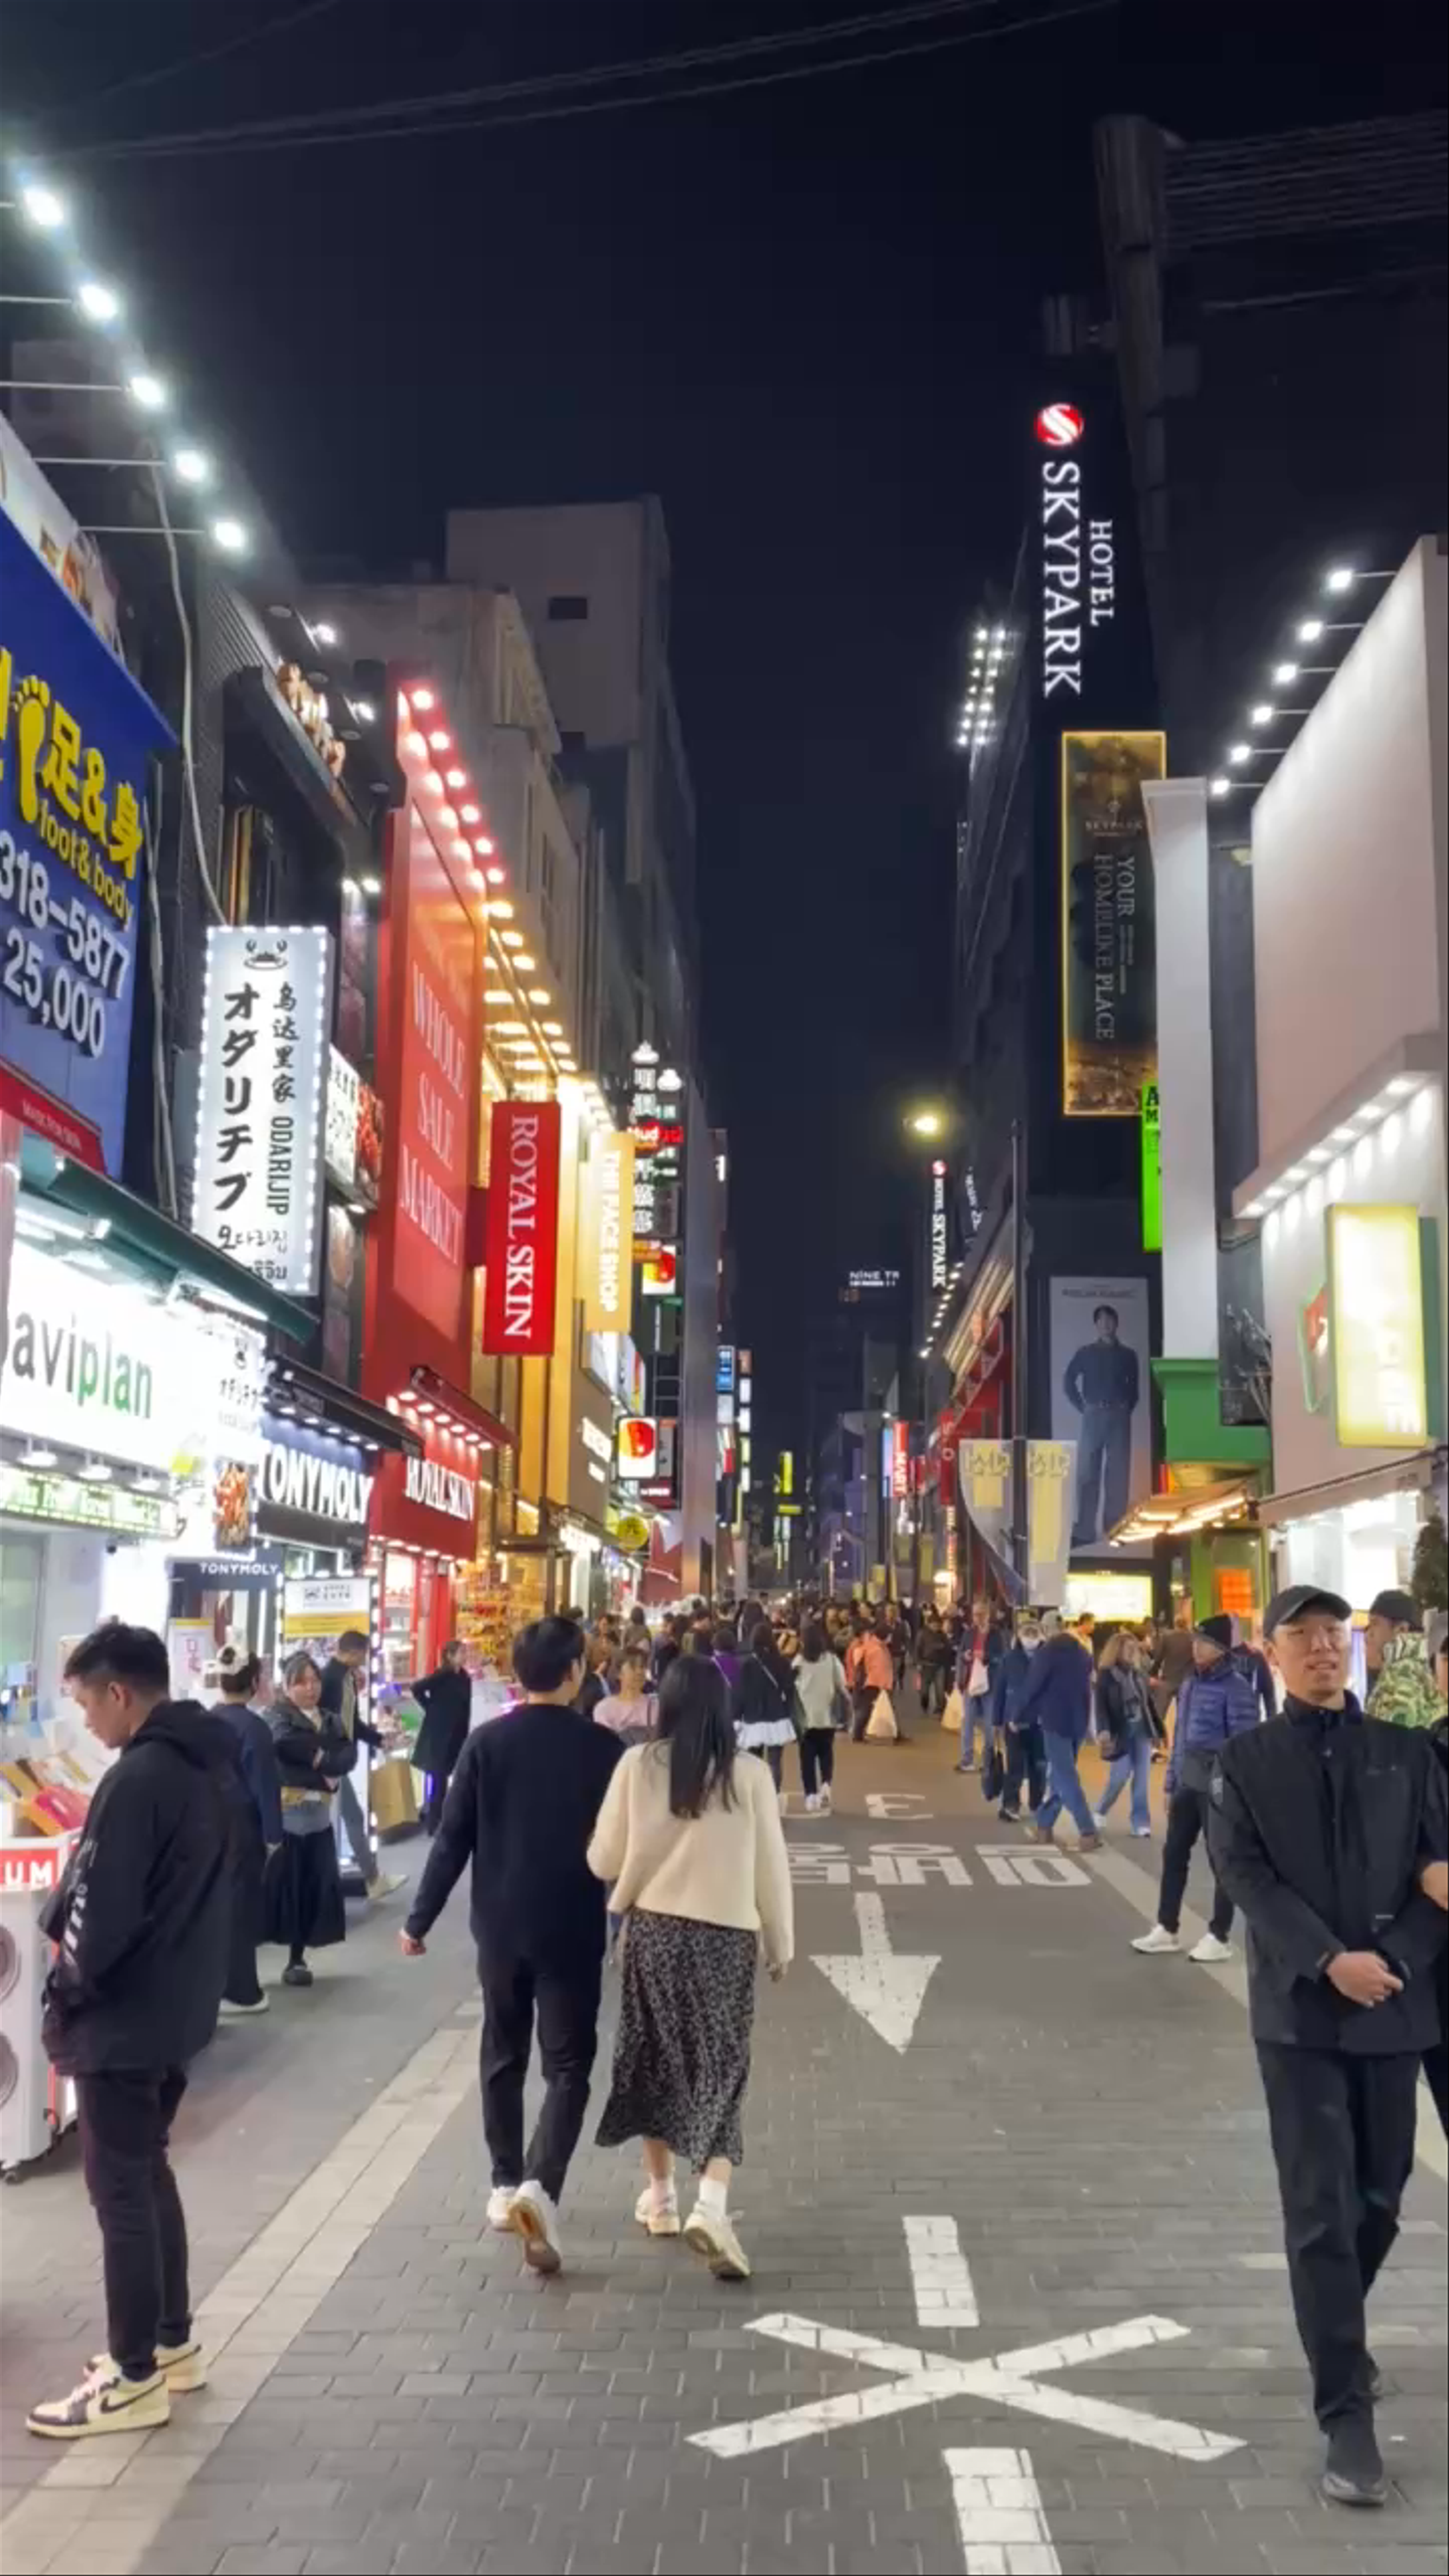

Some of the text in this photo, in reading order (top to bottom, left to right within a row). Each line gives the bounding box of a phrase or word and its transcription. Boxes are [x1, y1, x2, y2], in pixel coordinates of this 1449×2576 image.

[1043, 461, 1081, 698] SKYPARK
[1089, 520, 1114, 626] HOTEL
[0, 833, 130, 998] 318-5877
[1118, 856, 1134, 916] YOUR
[5, 926, 107, 1058] 25,000
[413, 961, 465, 1099] WHOLE
[1095, 973, 1114, 1040] PLACE
[266, 1117, 293, 1215] ODARIJIP
[417, 1072, 453, 1170] SALE
[400, 1144, 463, 1265] MARKET
[503, 1115, 538, 1338] ROYAL SKIN
[932, 1214, 946, 1287] SKYPARK
[0, 1312, 152, 1419] aviplan
[200, 1561, 279, 1576] TONYMOLY
[0, 1860, 53, 1886] UM
